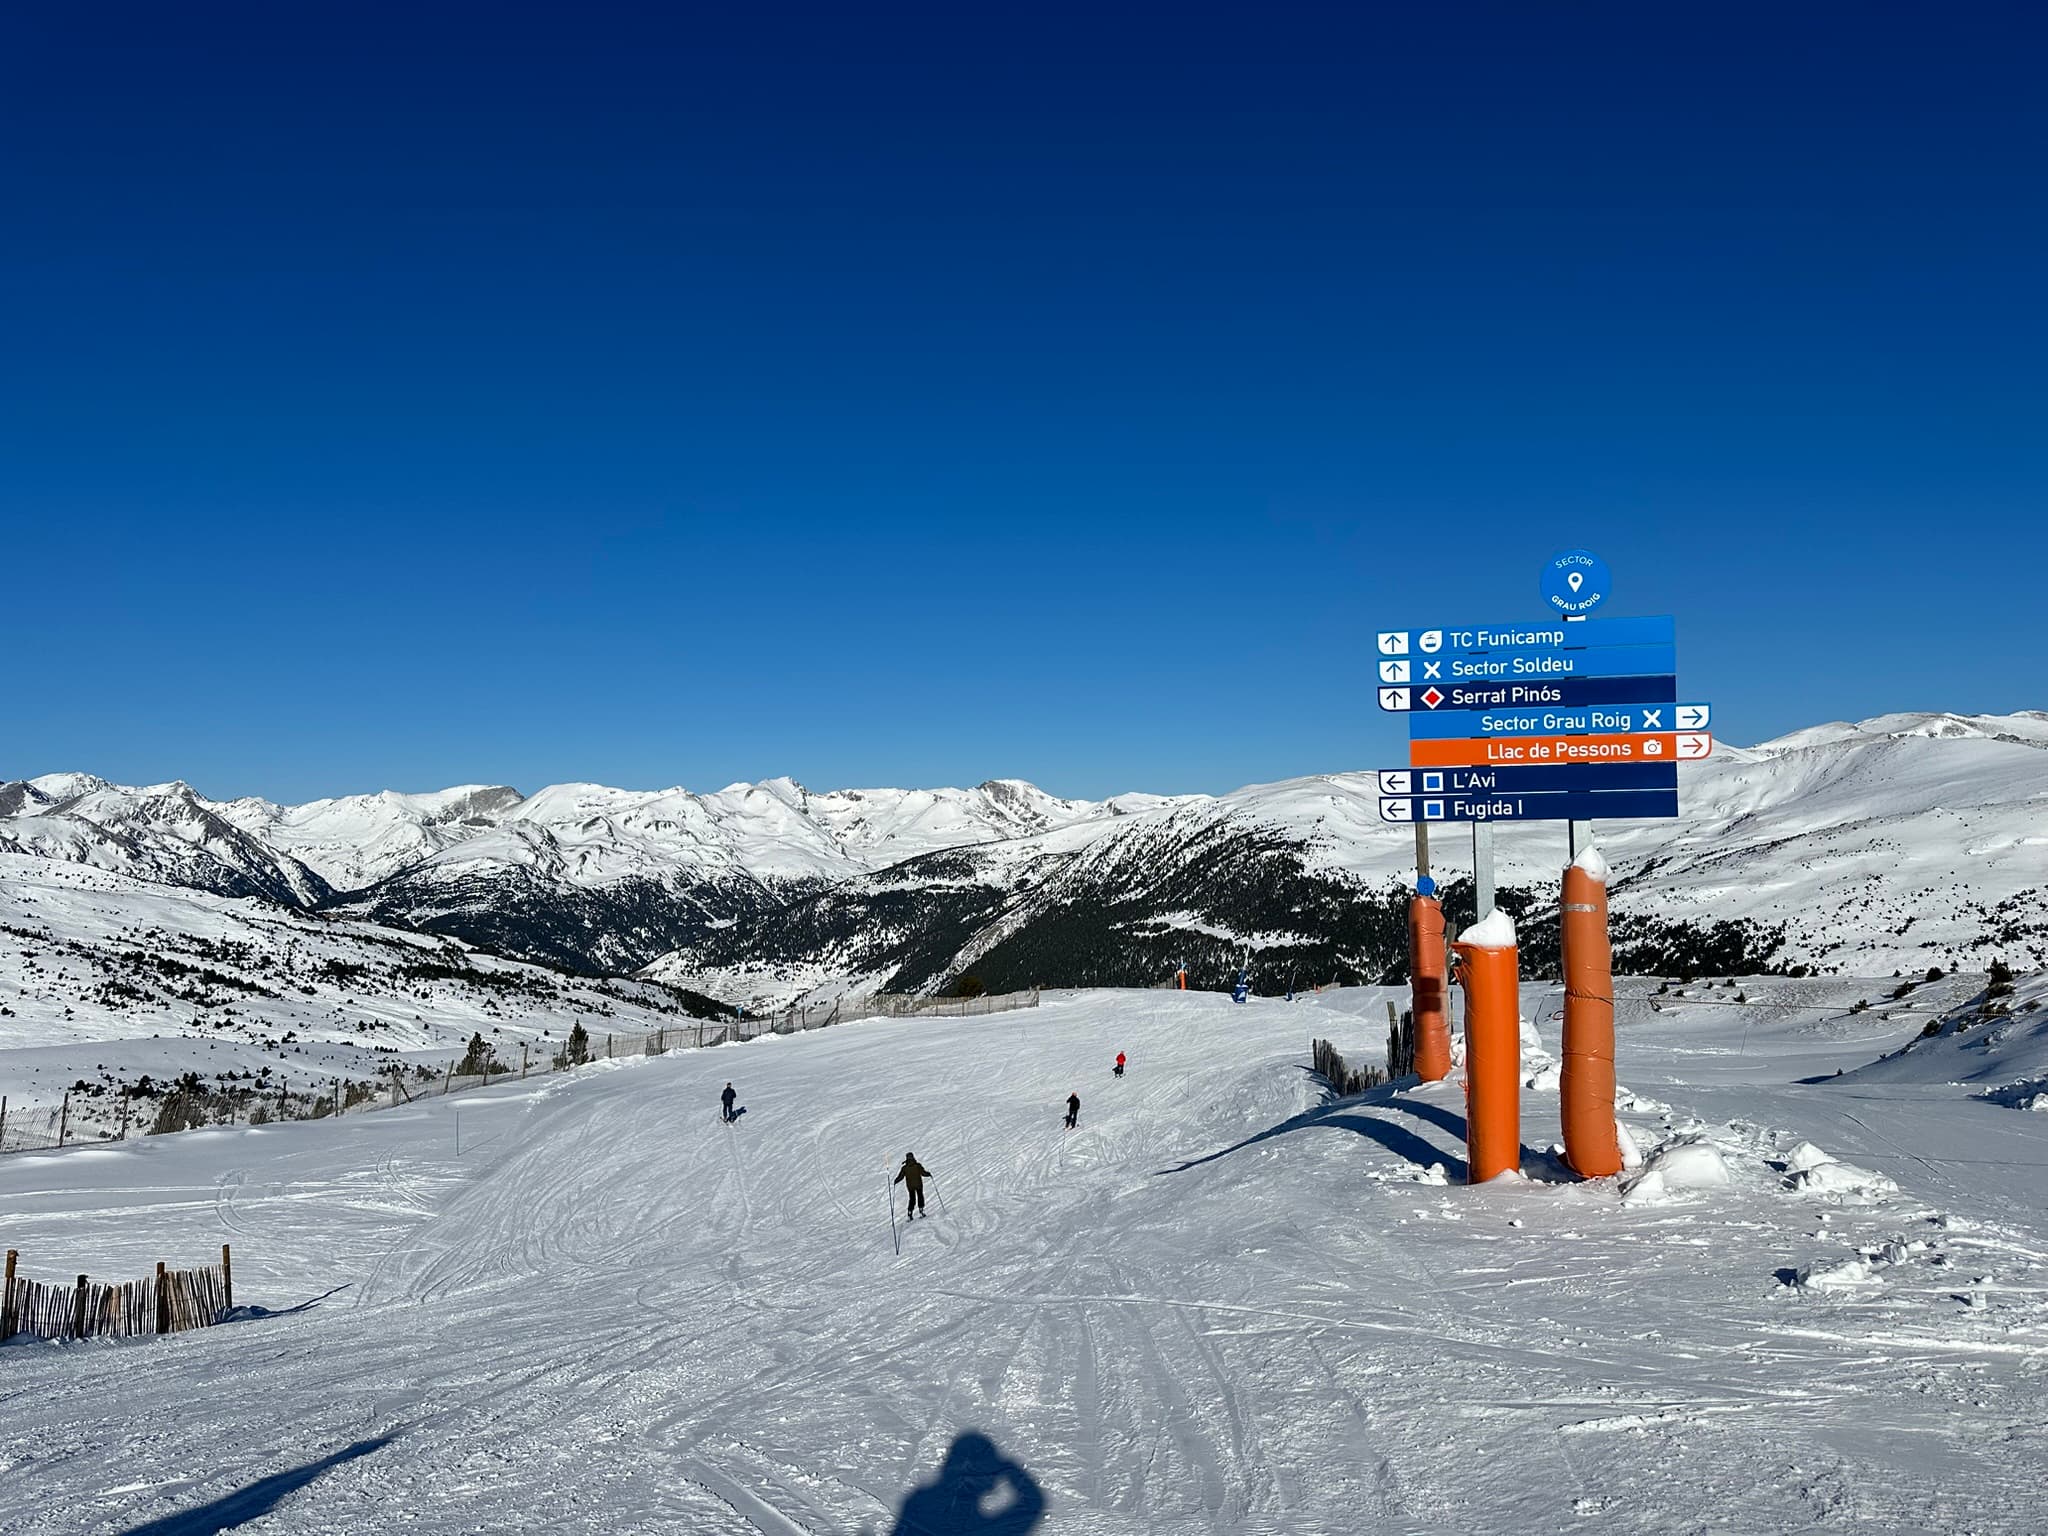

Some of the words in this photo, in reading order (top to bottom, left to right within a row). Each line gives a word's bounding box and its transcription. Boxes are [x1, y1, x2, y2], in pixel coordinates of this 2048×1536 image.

[1555, 555, 1593, 568] SECTOR
[1551, 595, 1576, 610] GRAU
[1579, 592, 1600, 610] ROIG
[1450, 632, 1472, 647] TC
[1478, 630, 1563, 646] Funicamp
[1452, 661, 1507, 675] Sector
[1513, 657, 1572, 673] Soldeu
[1452, 689, 1506, 704] Serrat
[1513, 686, 1561, 702] Pinós
[1482, 716, 1538, 731] Sector
[1544, 714, 1585, 729] Grau
[1592, 712, 1630, 730] Roig
[1488, 744, 1523, 759] Llac
[1530, 743, 1549, 758] de
[1556, 742, 1631, 757] Pessons
[1454, 800, 1512, 818] Fugida
